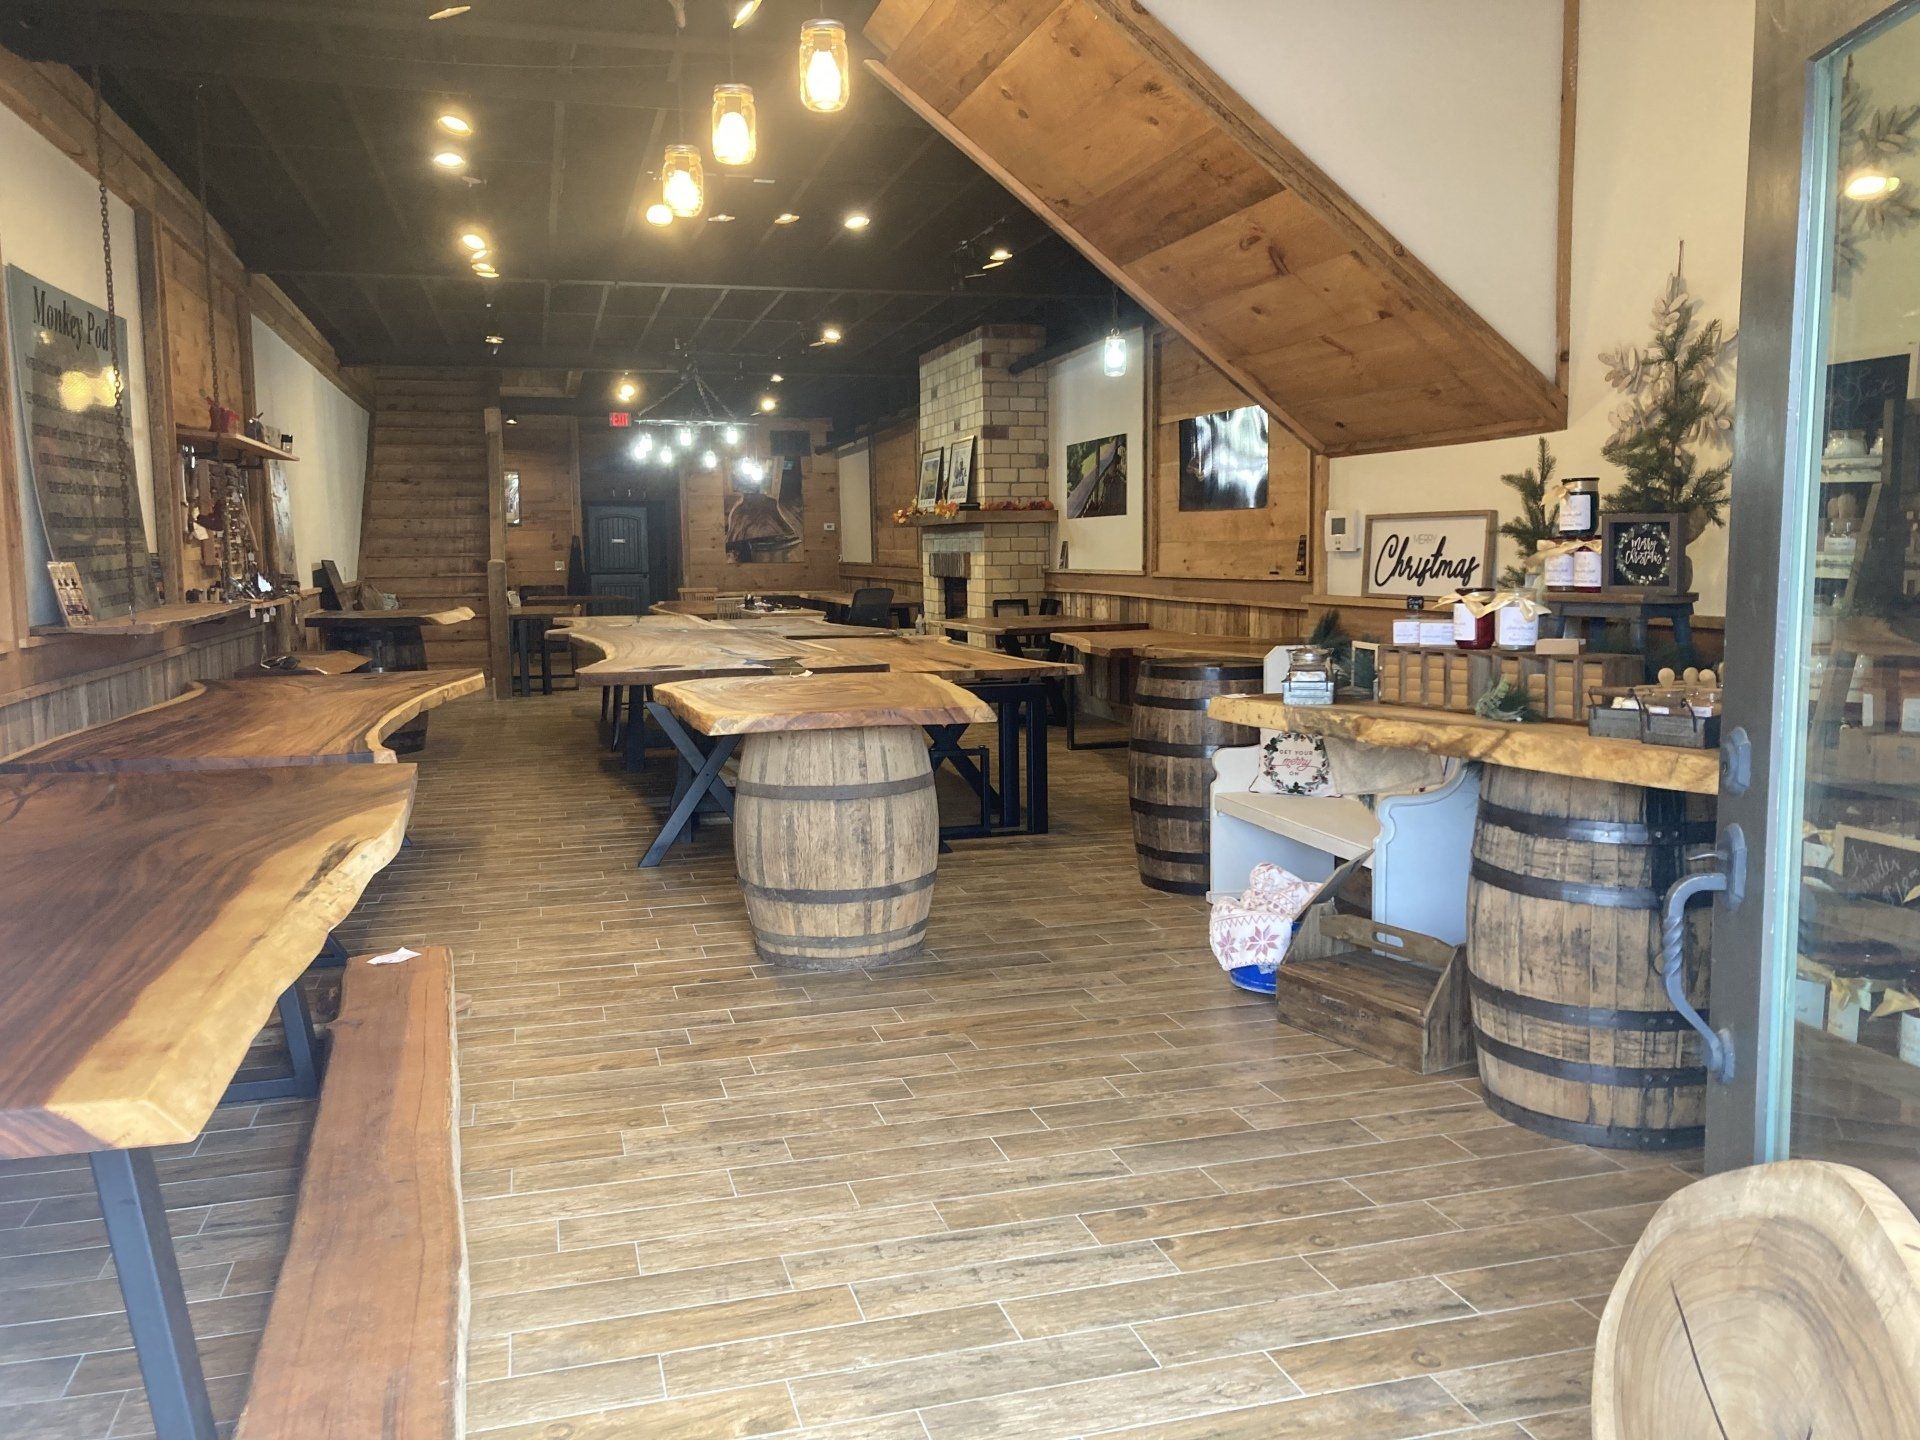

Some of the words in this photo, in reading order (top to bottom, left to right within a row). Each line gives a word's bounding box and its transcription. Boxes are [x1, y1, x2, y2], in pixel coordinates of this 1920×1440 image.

[33, 285, 83, 350] Monkey
[87, 310, 109, 351] Pod
[1374, 534, 1480, 587] Christmas
[1412, 533, 1438, 545] MERRY
